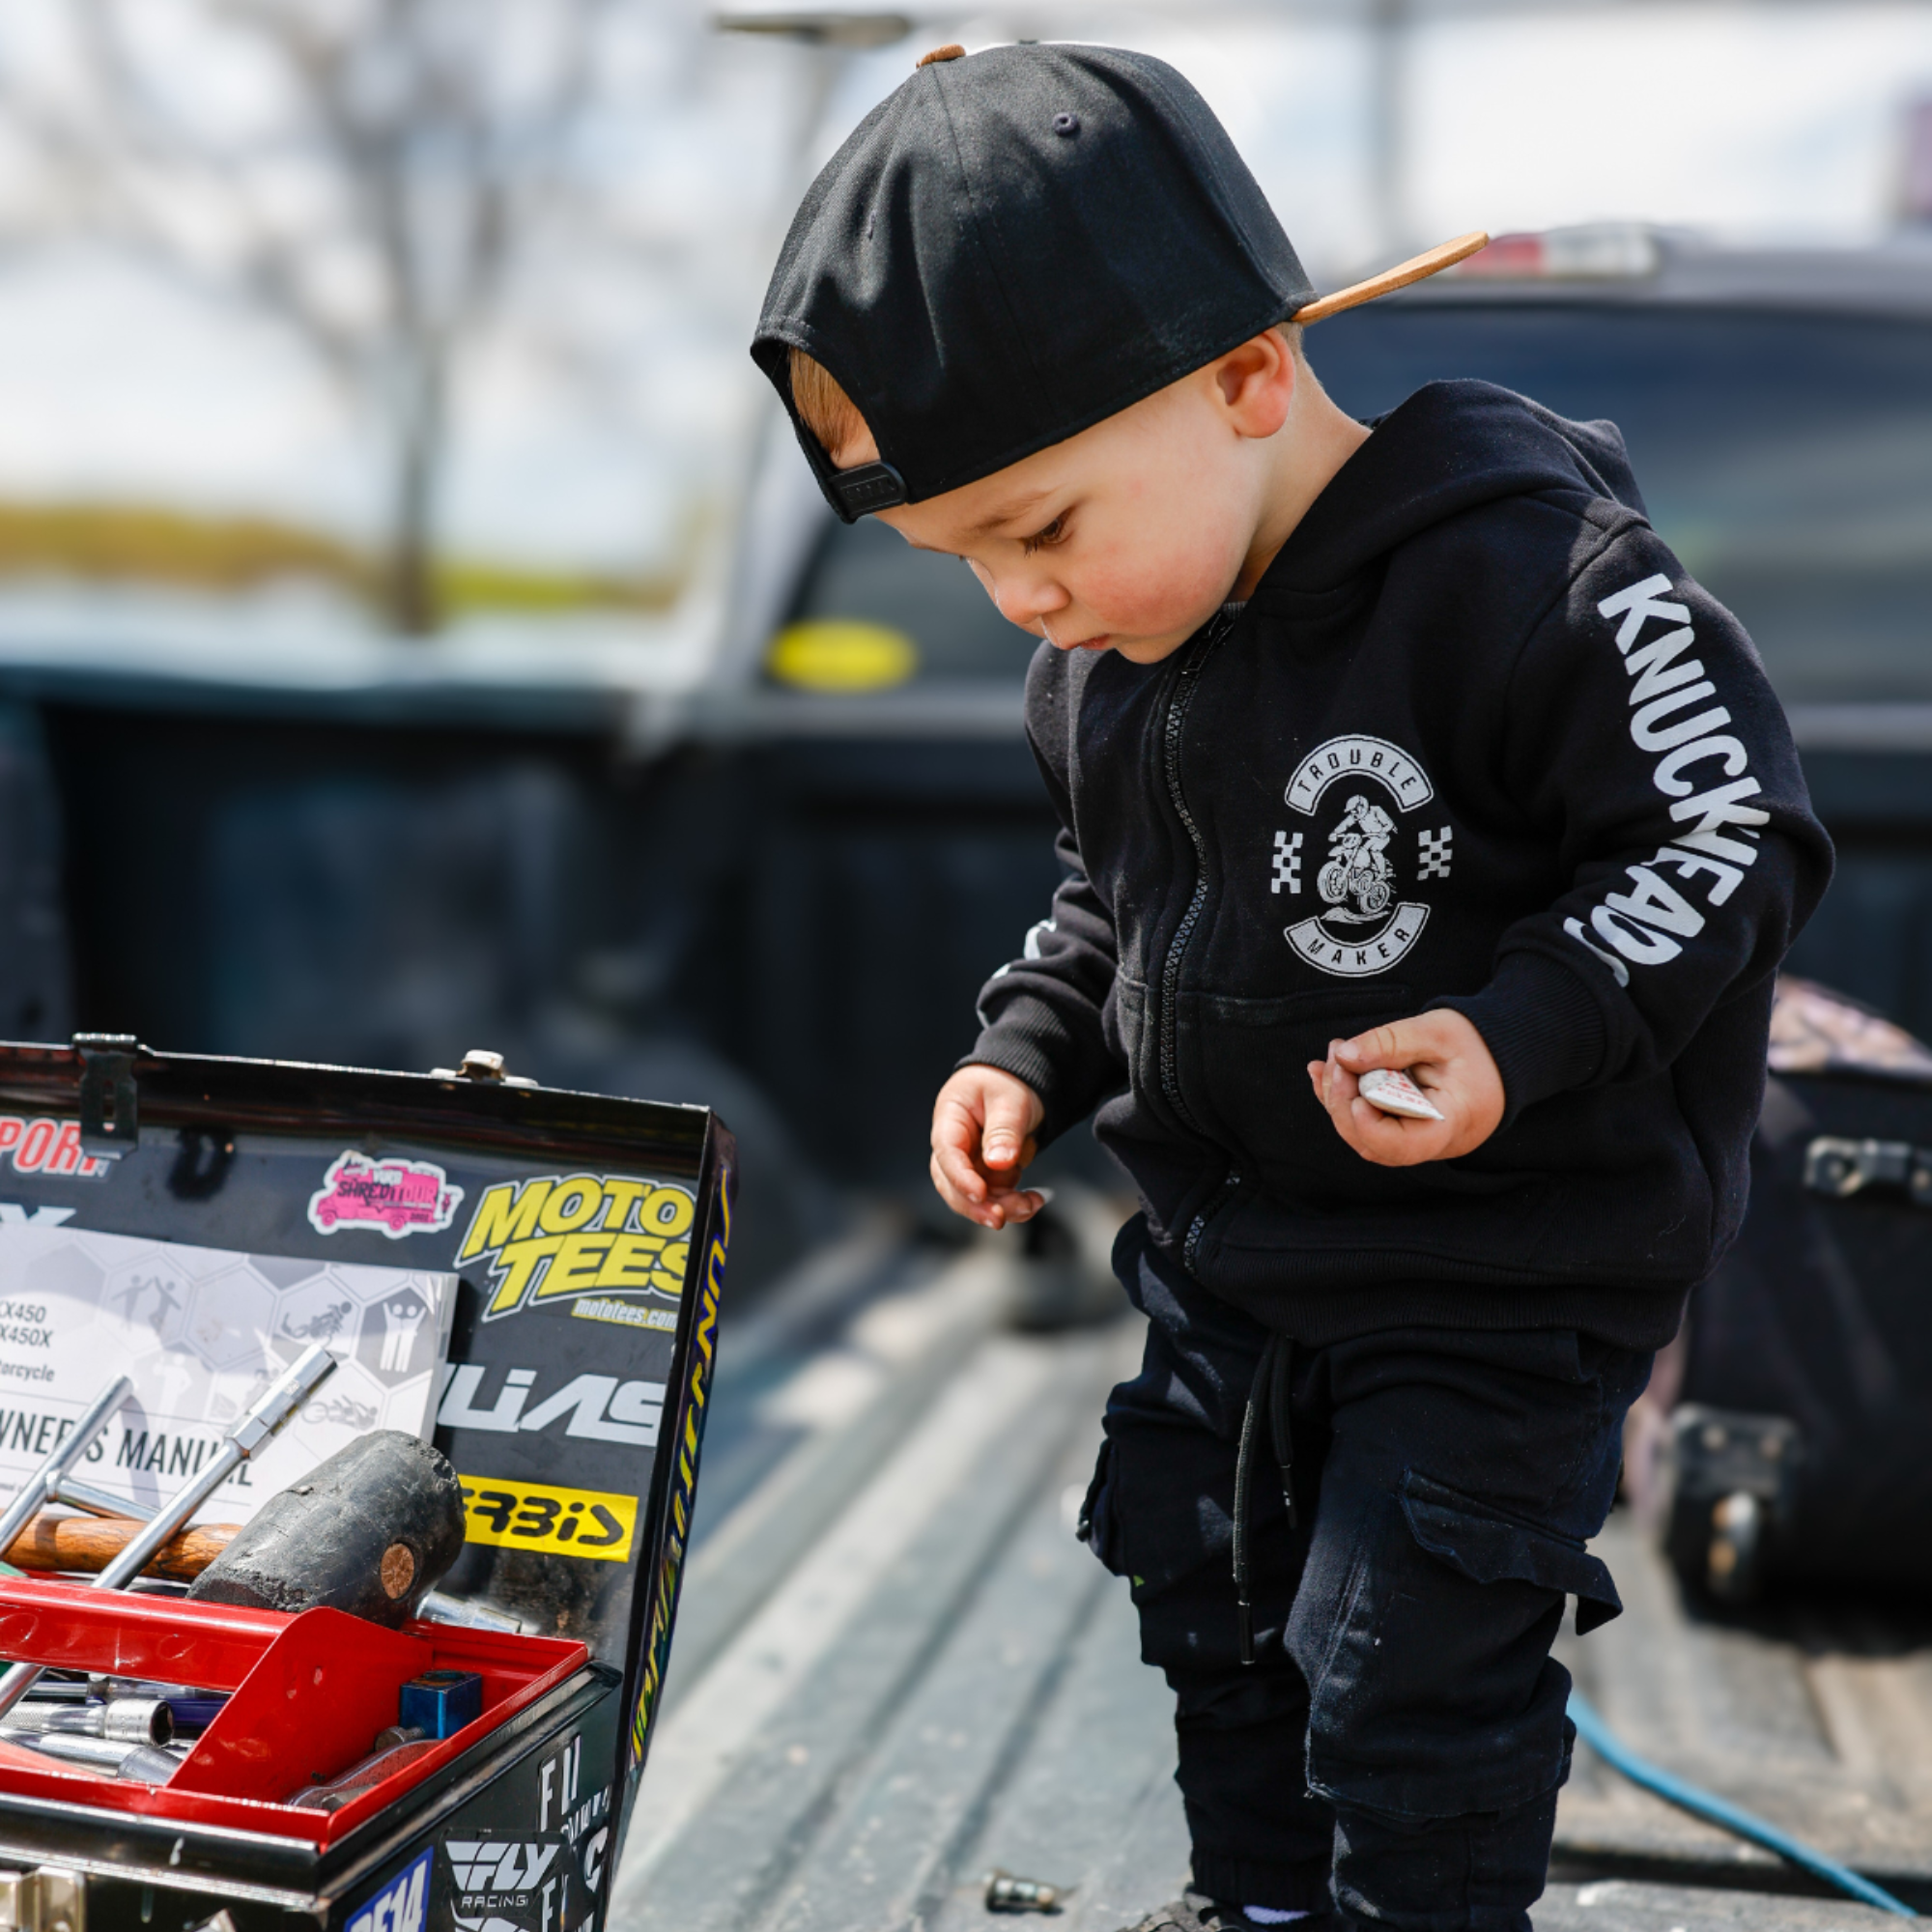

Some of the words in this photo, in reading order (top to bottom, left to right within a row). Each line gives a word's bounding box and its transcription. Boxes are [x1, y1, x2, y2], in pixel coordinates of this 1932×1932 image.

[1298, 749, 1417, 793] TROUBLE
[1307, 927, 1409, 965] MAKER
[462, 1177, 694, 1259] MOTO
[497, 1232, 690, 1312] TEES
[0, 1359, 55, 1382] orcycle
[445, 1841, 560, 1891] FLY
[461, 1894, 526, 1908] RACING
